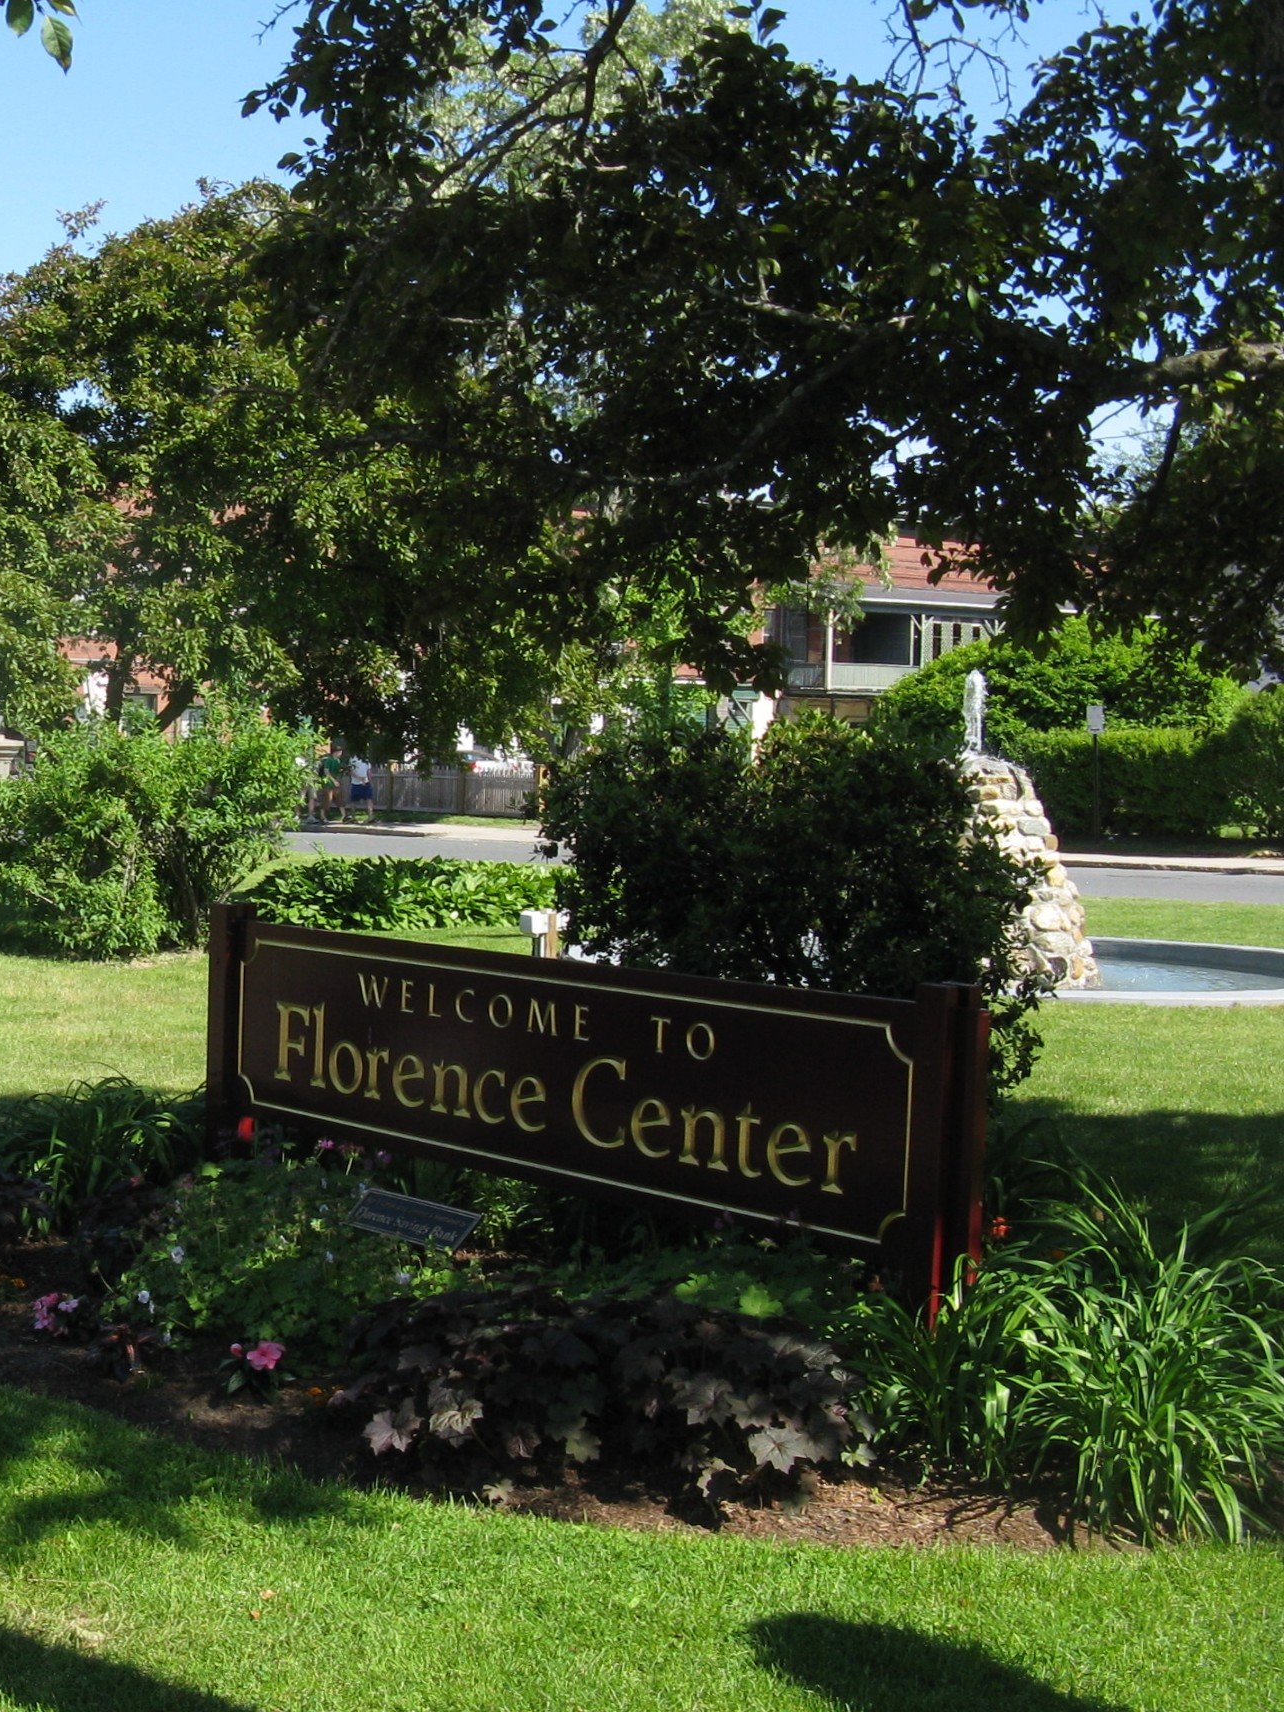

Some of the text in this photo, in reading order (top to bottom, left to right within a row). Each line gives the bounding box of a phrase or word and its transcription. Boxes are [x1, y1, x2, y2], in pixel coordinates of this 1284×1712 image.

[357, 972, 716, 1061] WELCOME TO
[273, 1000, 858, 1195] Florence Center
[429, 1225, 458, 1242] Bank
